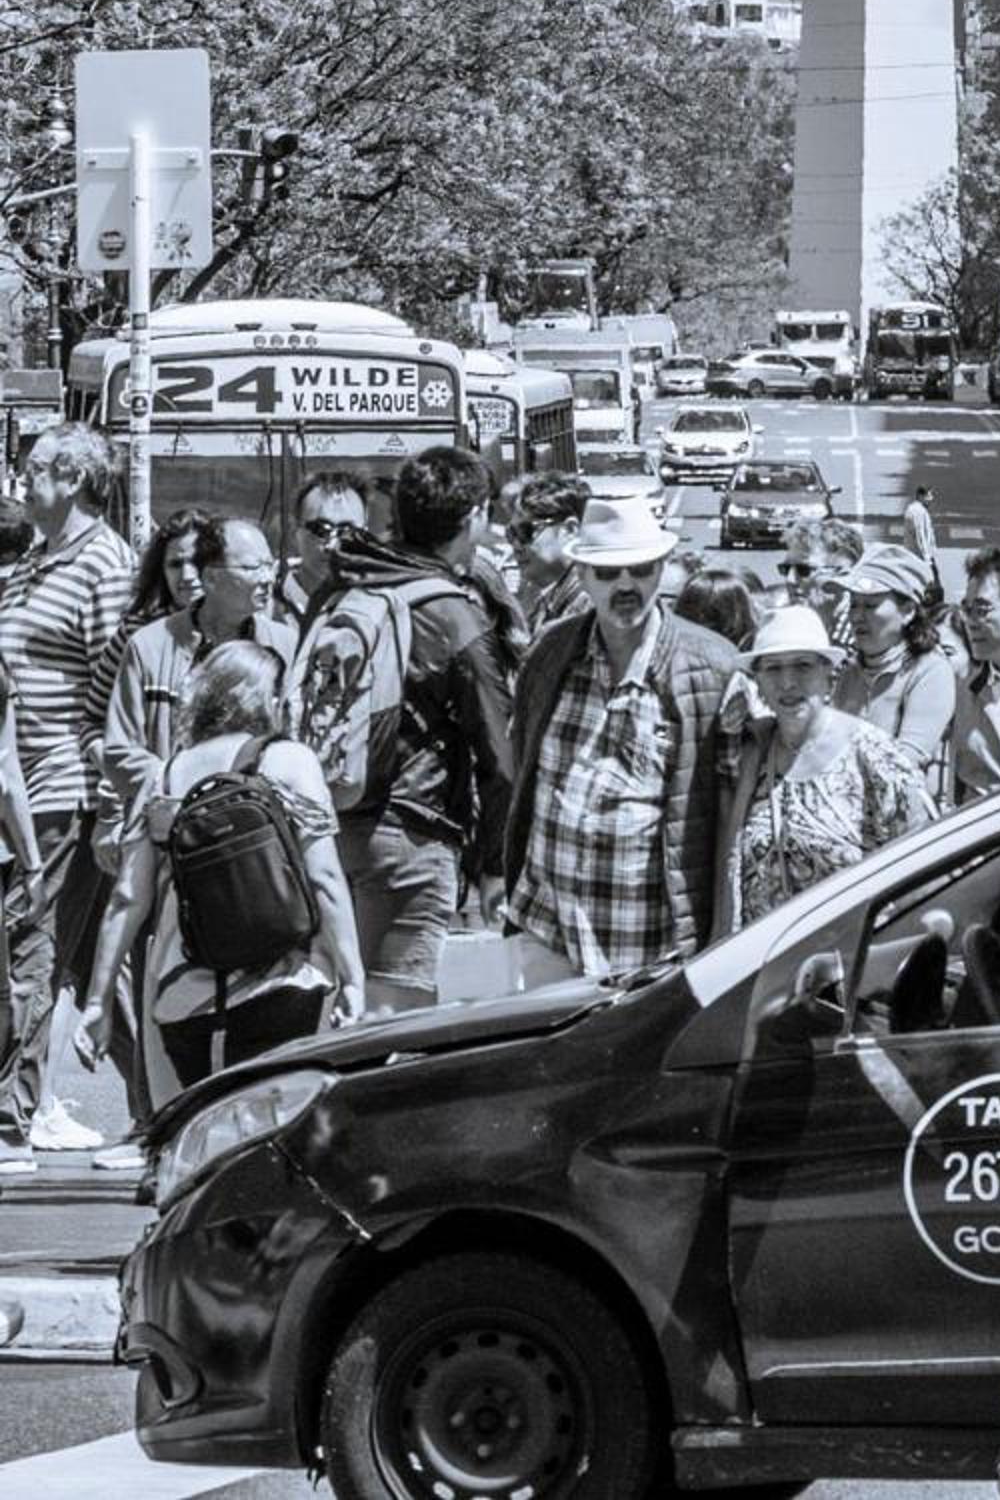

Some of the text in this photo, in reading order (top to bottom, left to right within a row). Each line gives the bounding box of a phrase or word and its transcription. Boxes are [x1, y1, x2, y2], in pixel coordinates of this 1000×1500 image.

[292, 367, 416, 388] WILDE
[152, 366, 283, 414] 24
[293, 393, 416, 414] V. DEL PARQUE
